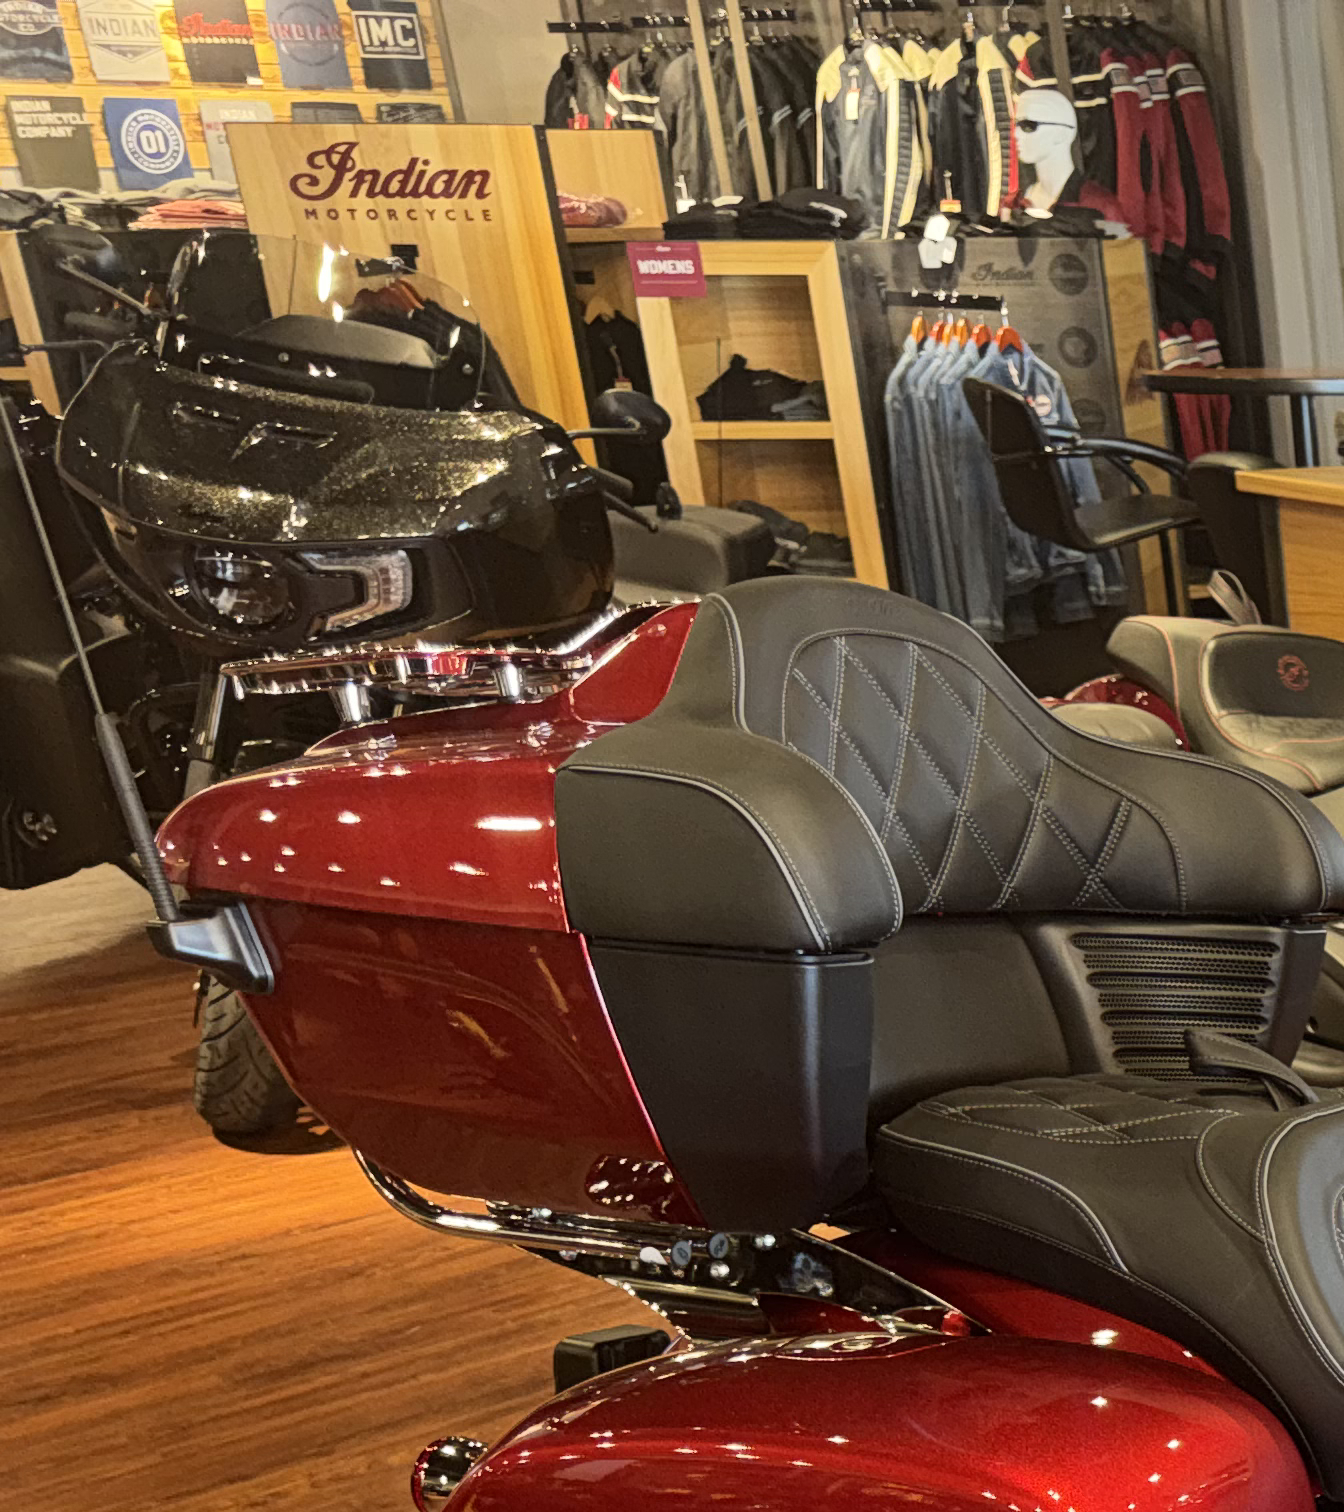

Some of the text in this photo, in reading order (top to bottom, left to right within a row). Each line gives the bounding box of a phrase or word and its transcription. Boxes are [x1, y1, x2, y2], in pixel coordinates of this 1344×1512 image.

[87, 17, 158, 38] INDIAN
[358, 17, 416, 48] IMC
[140, 130, 166, 154] 01
[289, 141, 492, 201] Indian
[304, 208, 492, 222] MOTORCYCLE
[637, 259, 695, 274] WOMENS
